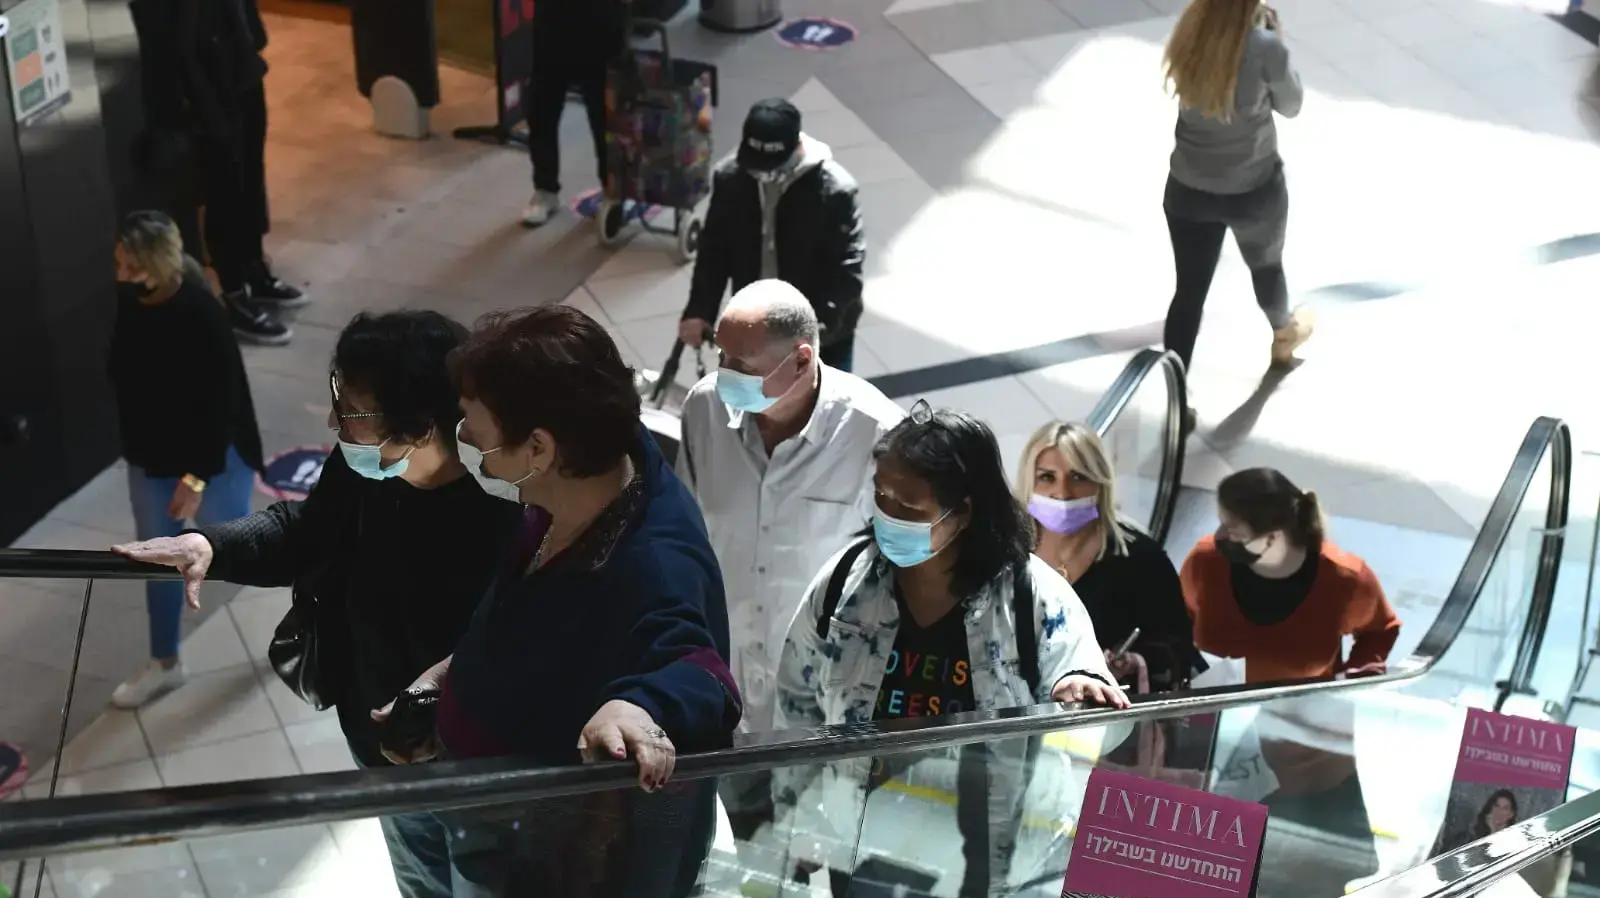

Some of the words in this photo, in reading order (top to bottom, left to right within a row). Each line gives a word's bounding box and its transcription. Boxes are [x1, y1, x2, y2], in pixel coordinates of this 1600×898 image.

[1470, 717, 1563, 753] INTIMA
[1097, 786, 1248, 848] INTIMA
[1086, 832, 1159, 864] בשבילך!
[1160, 851, 1242, 883] התחדשנו
